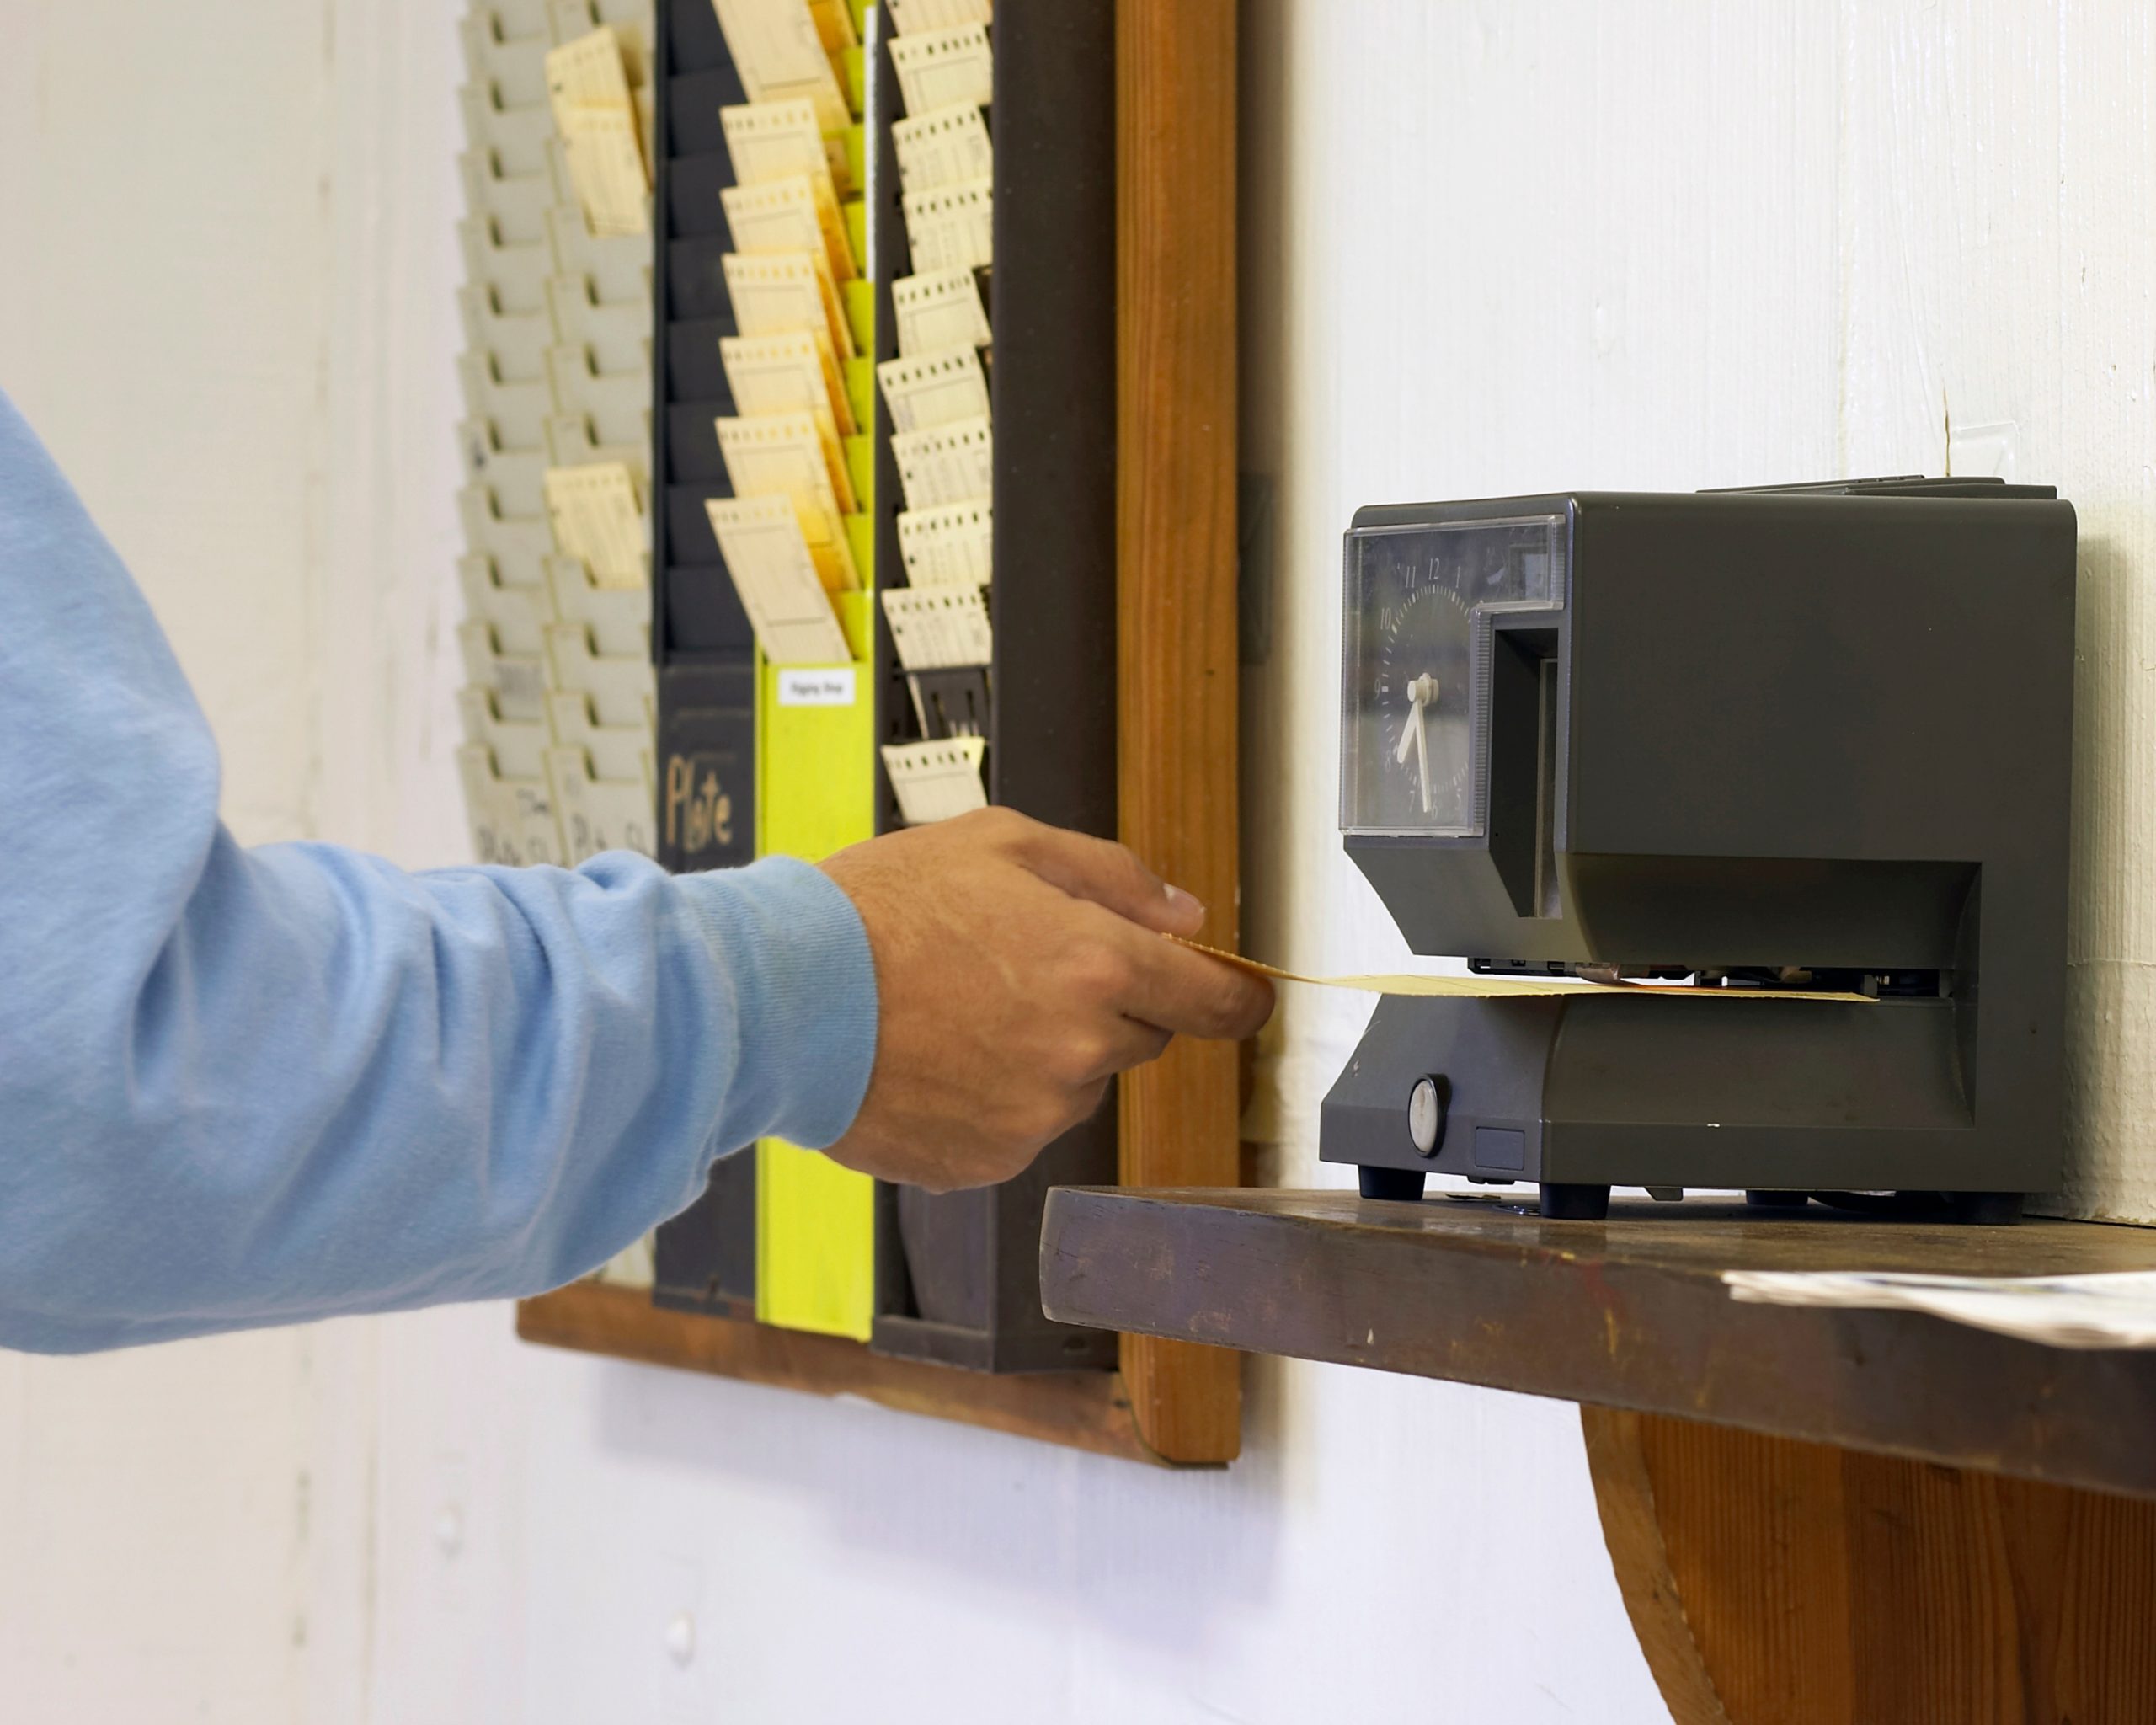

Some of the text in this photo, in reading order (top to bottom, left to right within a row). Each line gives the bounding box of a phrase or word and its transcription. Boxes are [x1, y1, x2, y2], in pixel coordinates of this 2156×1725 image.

[1405, 565, 1416, 588] 11
[1428, 558, 1439, 580] 12
[1455, 565, 1461, 589] 1
[1380, 607, 1391, 630] 10
[1374, 678, 1380, 701] 9
[1385, 750, 1391, 772] 8
[1409, 790, 1415, 814] 7
[1432, 798, 1438, 820] 6
[1454, 788, 1462, 811] 5
